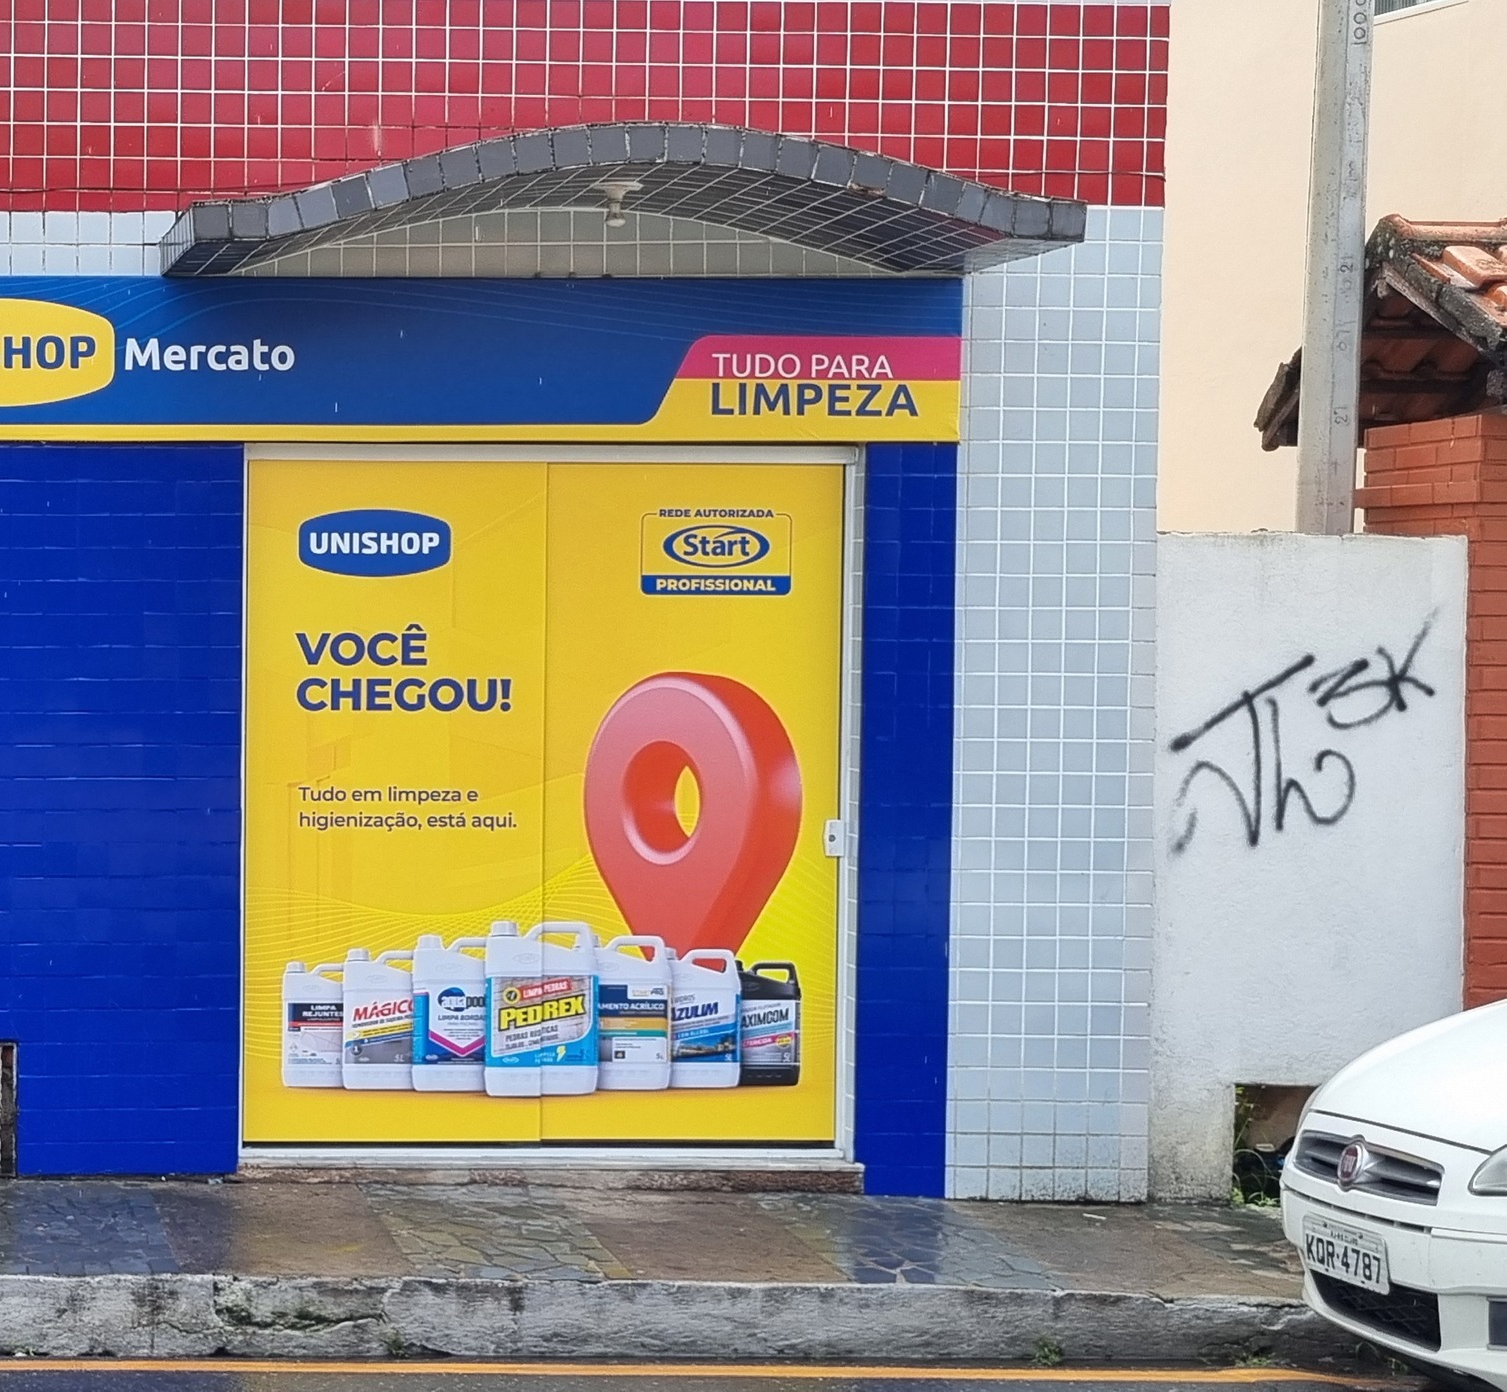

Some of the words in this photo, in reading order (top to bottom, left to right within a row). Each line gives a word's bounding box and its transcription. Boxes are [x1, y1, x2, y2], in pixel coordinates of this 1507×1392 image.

[124, 337, 296, 372] Mercato
[711, 353, 801, 379] TUDO
[810, 354, 894, 379] PARA
[711, 382, 919, 417] LIMPEZA
[658, 509, 691, 518] REDE
[694, 509, 775, 519] AUTORIZADA
[309, 531, 441, 556] UNISHOP
[682, 532, 751, 558] Start
[656, 578, 776, 592] PROFISSIONAL
[295, 623, 428, 667] VOCÊ
[296, 677, 512, 712] CHEGOU!
[299, 786, 347, 803] Tudo
[351, 790, 382, 803] em
[387, 785, 462, 807] limpeza
[467, 790, 479, 803] e
[299, 811, 422, 834] higienização,
[426, 811, 467, 829] está
[471, 812, 518, 834] aqui.
[498, 994, 586, 1031] PEDREX
